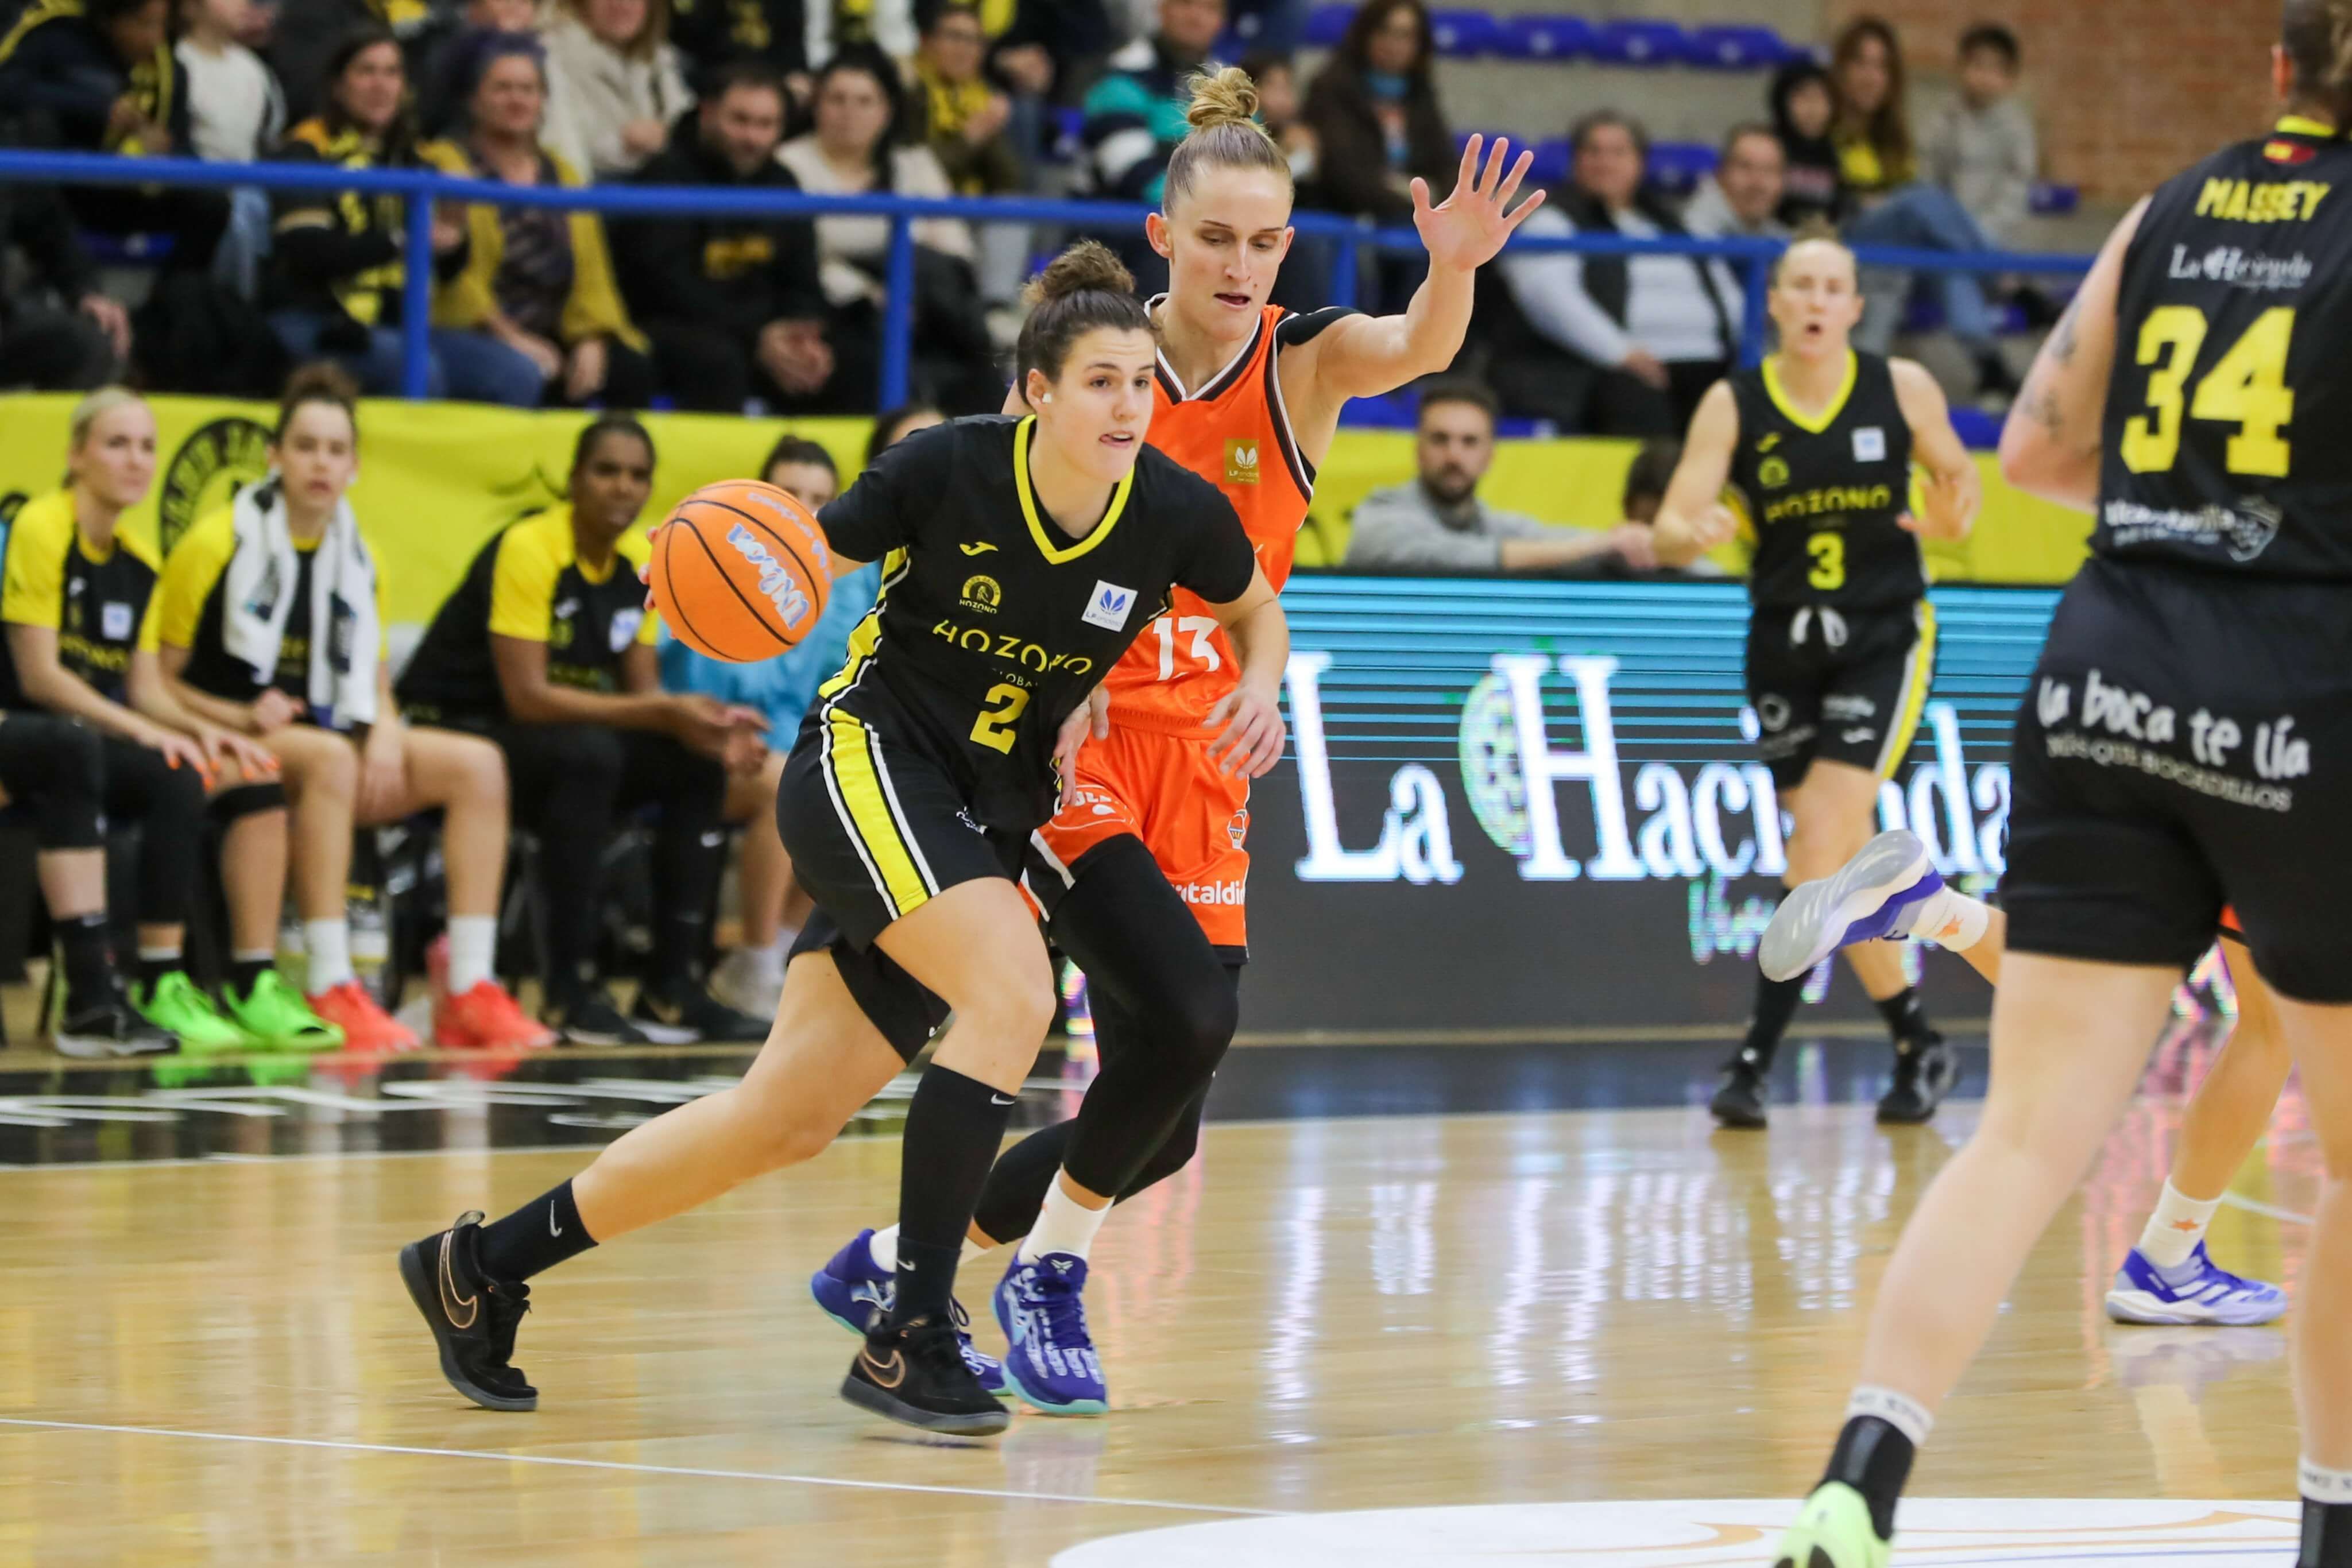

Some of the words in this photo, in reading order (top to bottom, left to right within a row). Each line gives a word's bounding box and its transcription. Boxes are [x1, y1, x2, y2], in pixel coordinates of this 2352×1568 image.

[2195, 177, 2331, 223] MASSEY
[2121, 305, 2295, 478] 34
[726, 523, 809, 630] Wilson
[1808, 532, 1846, 590] 3
[959, 599, 997, 614] HOZONO
[1152, 615, 1220, 682] 13
[969, 683, 1030, 755] 2
[2082, 668, 2176, 743] boca
[2188, 707, 2242, 766] te
[1285, 650, 1465, 885] La
[1490, 653, 2010, 881] Hacida
